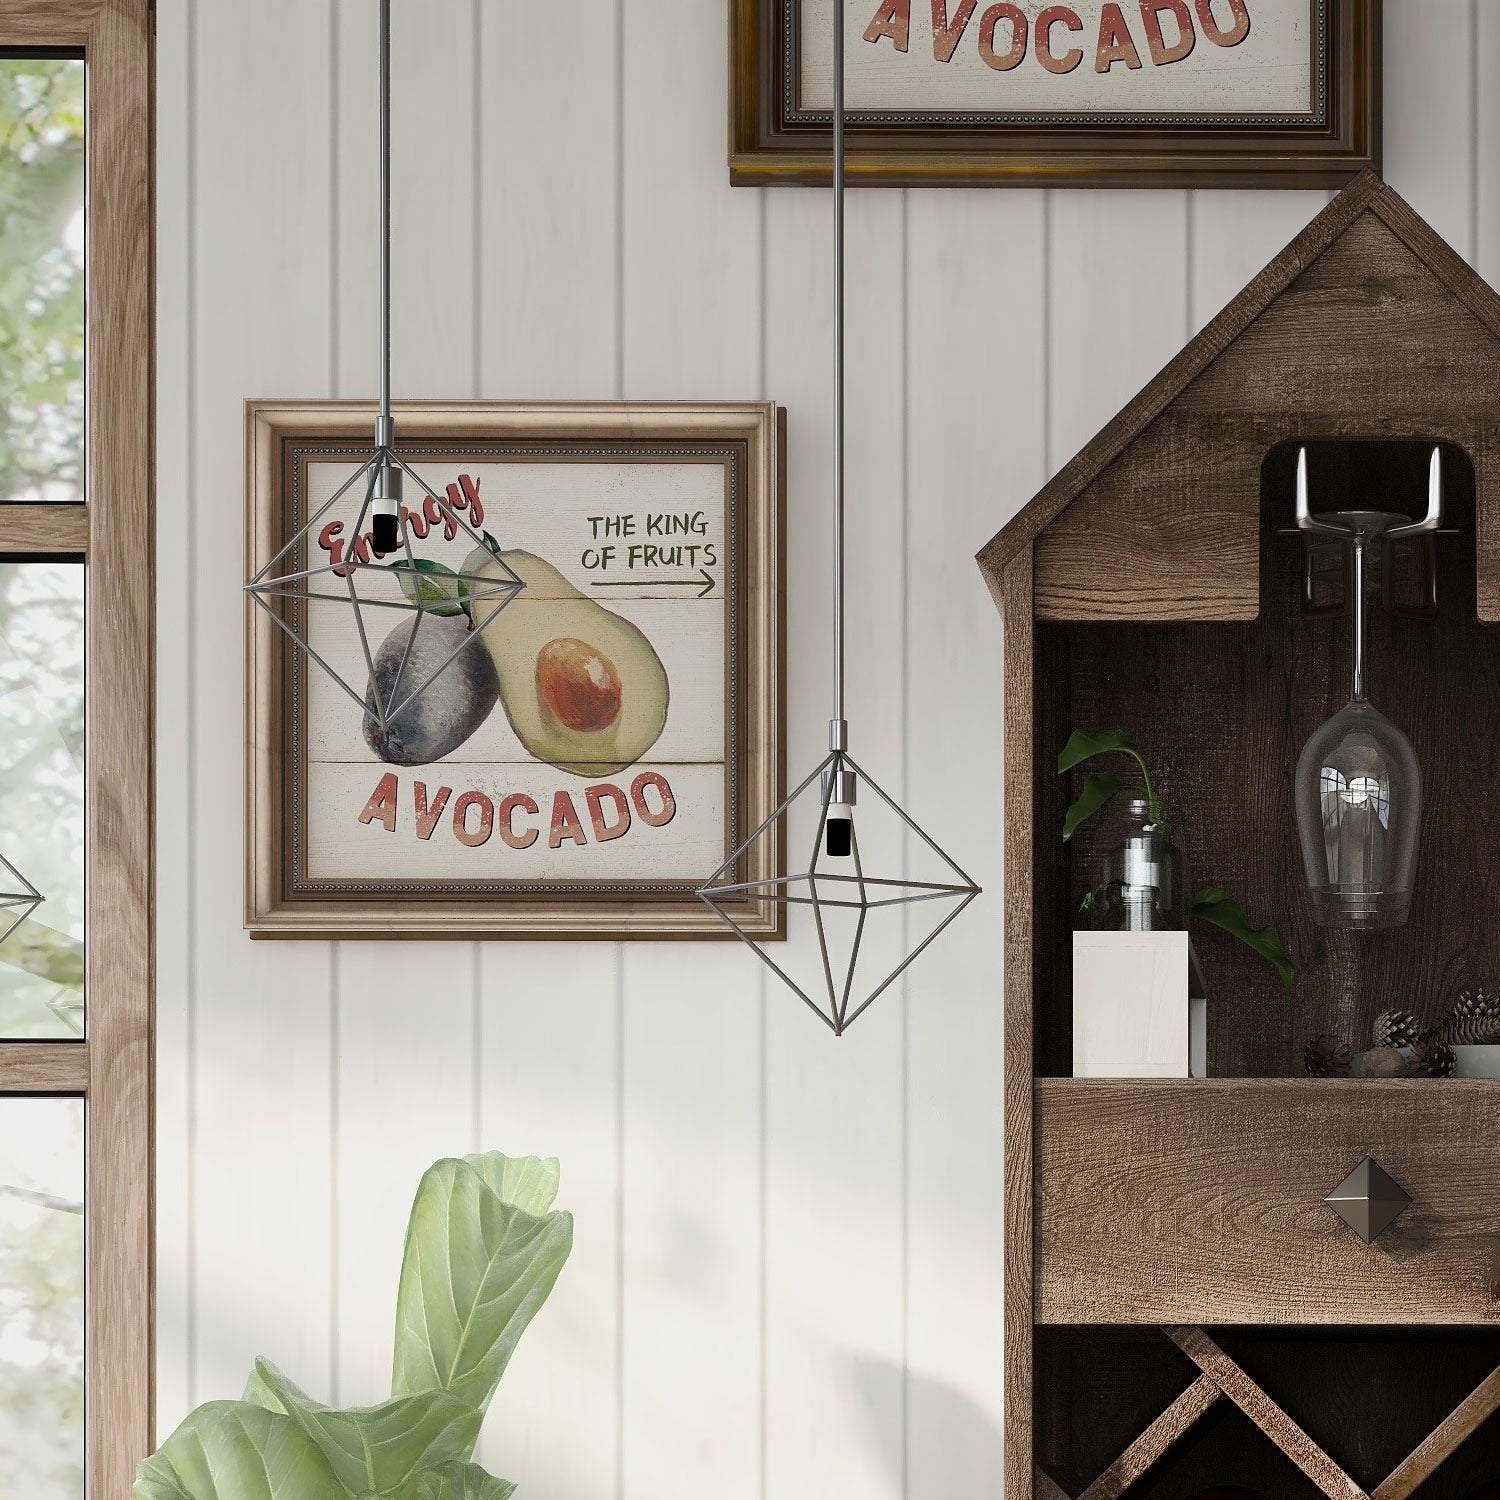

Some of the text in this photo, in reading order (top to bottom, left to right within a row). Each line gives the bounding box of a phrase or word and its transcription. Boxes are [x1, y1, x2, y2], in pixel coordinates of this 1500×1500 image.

[862, 0, 1251, 74] AVOCADO
[318, 474, 484, 577] Enrgy
[581, 545, 718, 570] OF FRUITS
[586, 511, 709, 538] THE KING
[357, 772, 678, 850] AVOCADO
